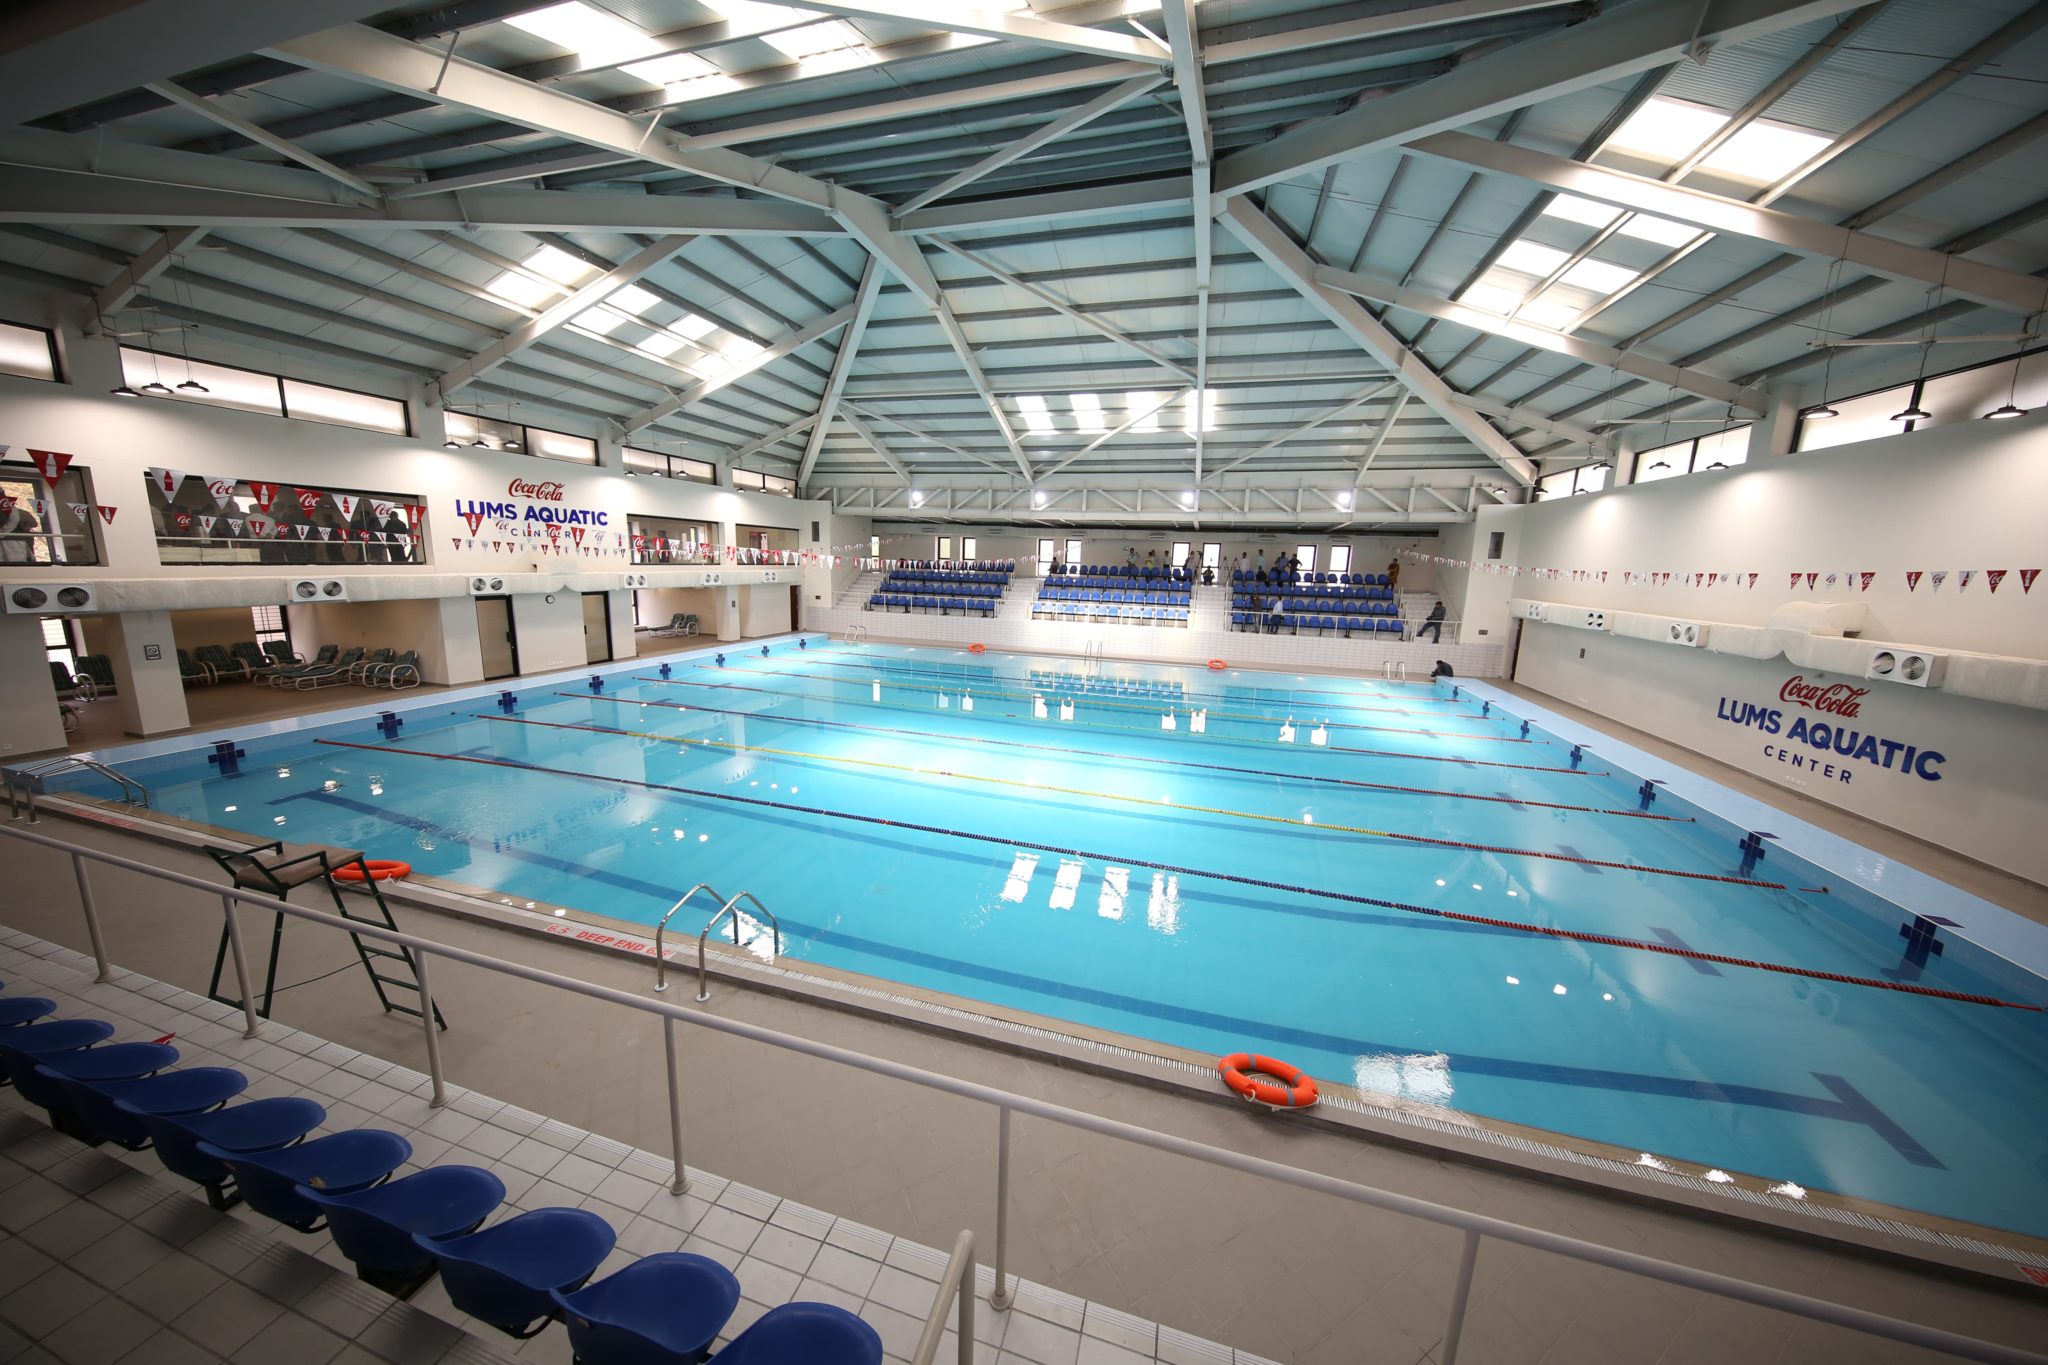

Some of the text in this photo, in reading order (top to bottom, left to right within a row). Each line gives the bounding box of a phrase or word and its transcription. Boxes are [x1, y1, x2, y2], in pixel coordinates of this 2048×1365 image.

[508, 478, 565, 501] Coca-Cola
[455, 499, 608, 526] LUMS AQUATIC
[1779, 675, 1870, 718] Coca-Cola
[1717, 697, 1946, 781] LUMS AQUATIC
[1764, 745, 1852, 784] CENTER
[575, 931, 614, 943] DEEP
[614, 940, 645, 951] END
